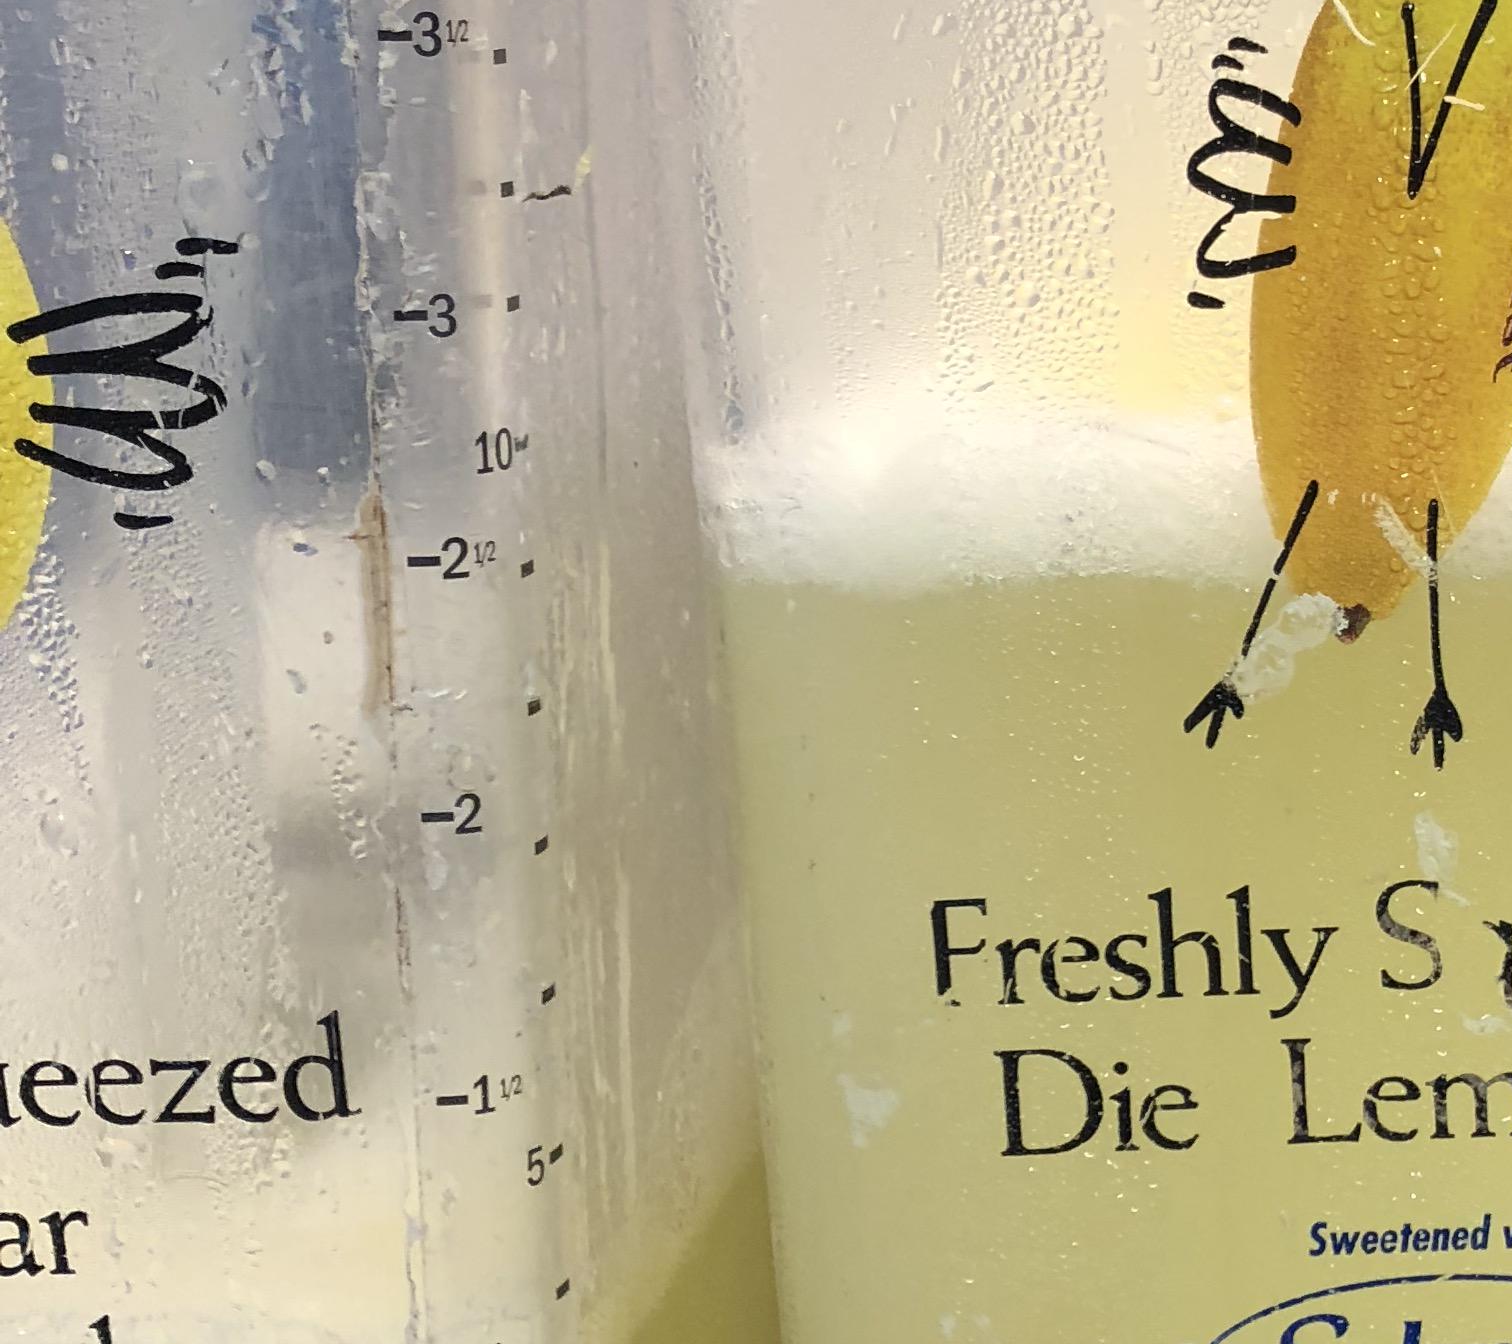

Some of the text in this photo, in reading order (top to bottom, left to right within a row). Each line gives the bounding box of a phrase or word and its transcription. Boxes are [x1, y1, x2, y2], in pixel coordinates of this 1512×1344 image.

[427, 292, 458, 338] 3
[453, 792, 484, 837] 2
[931, 885, 1339, 1019] Freshly
[525, 1143, 546, 1187] 5
[1308, 1213, 1492, 1258] Sweetened
